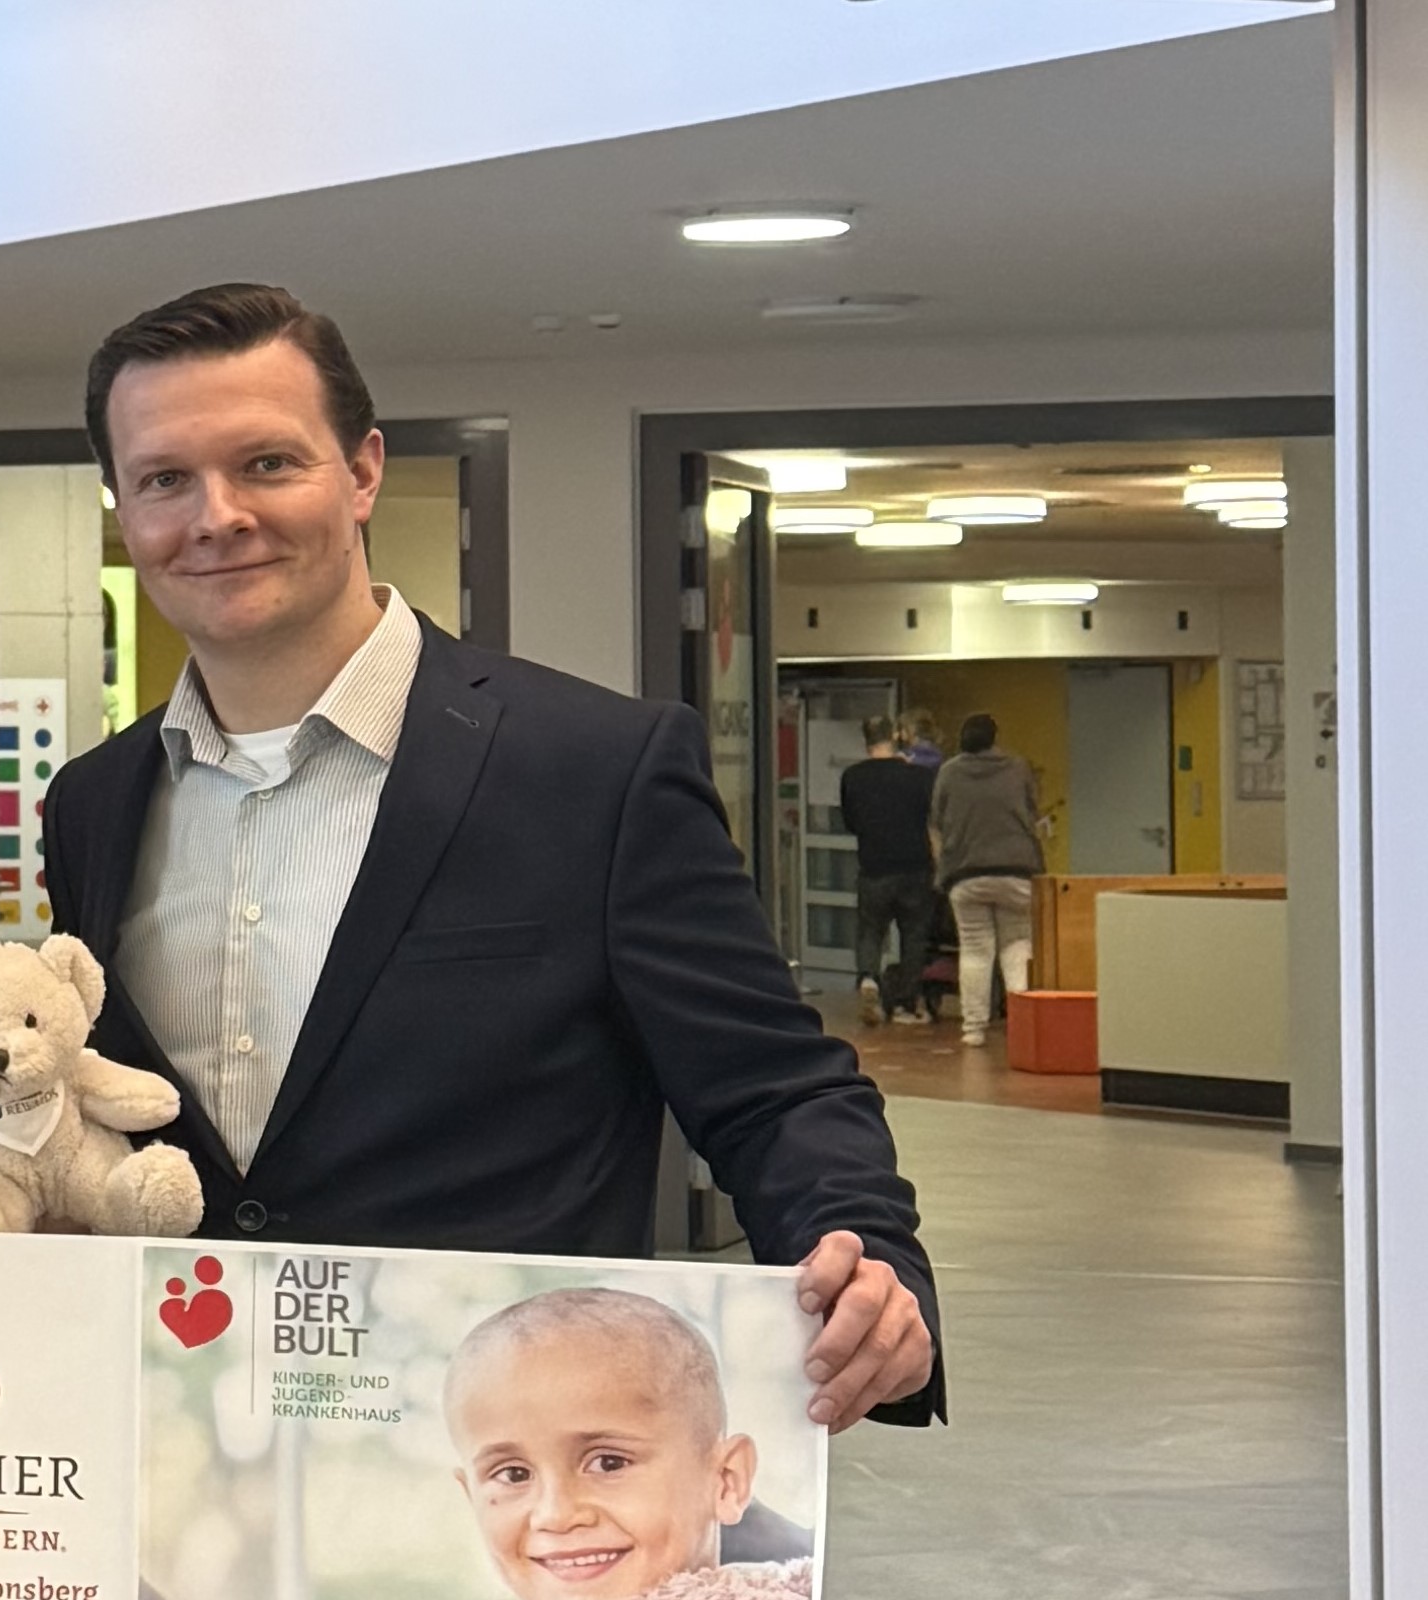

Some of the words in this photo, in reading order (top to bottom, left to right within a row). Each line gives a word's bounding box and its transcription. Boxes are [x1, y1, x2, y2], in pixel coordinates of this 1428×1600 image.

[275, 1258, 351, 1291] AUF
[274, 1291, 351, 1324] DER
[273, 1324, 369, 1358] BULT
[272, 1370, 344, 1387] KINDER-
[350, 1375, 390, 1389] UND
[271, 1387, 353, 1403] JUGEND-
[272, 1403, 401, 1423] KRANKENHAUS
